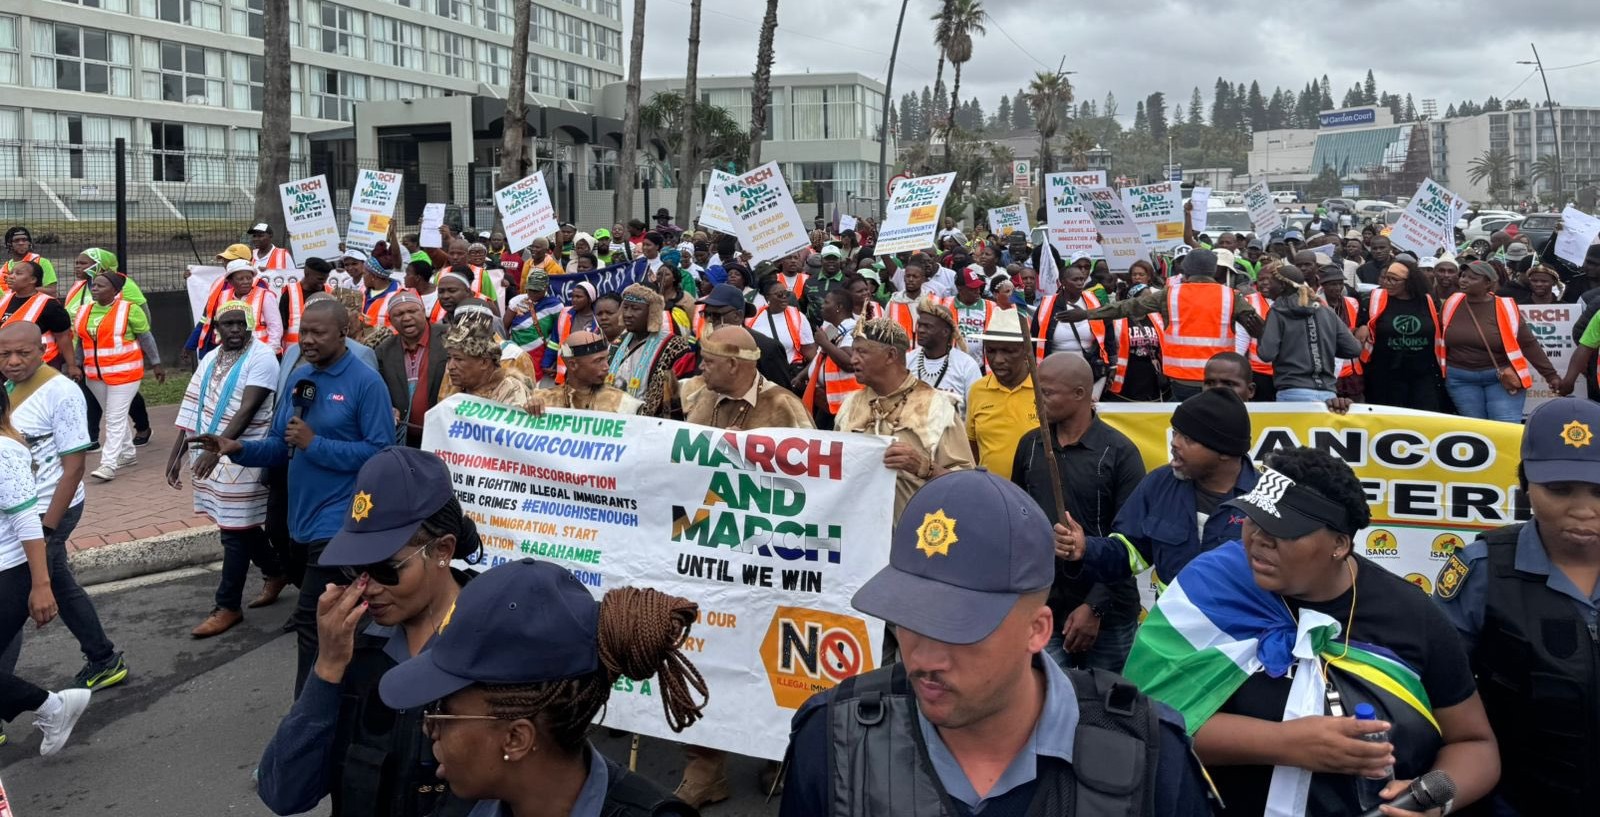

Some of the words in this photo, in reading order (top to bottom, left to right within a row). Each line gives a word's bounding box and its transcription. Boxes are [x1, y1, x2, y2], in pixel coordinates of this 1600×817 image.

[1329, 113, 1352, 123] Garden
[1354, 112, 1372, 120] Court
[365, 172, 396, 183] MARCH
[369, 181, 387, 190] AND
[724, 168, 773, 195] MARCH
[901, 176, 947, 189] MARCH
[1053, 175, 1099, 186] MARCH
[286, 179, 321, 196] MARCH
[502, 176, 538, 198] MARCH
[512, 187, 533, 200] AND
[740, 184, 767, 198] AND
[909, 186, 934, 195] AND
[1130, 184, 1171, 196] MARCH
[295, 192, 316, 203] AND
[1080, 190, 1113, 201] MARCH
[1140, 195, 1164, 203] AND
[742, 211, 757, 221] UNTIL
[769, 201, 778, 209] WIN
[1092, 201, 1112, 210] AND
[1430, 197, 1450, 212] AND
[759, 212, 784, 227] DEMAND
[752, 229, 775, 243] JUSTICE
[778, 221, 790, 231] AND
[756, 231, 795, 251] PROTECTION
[1520, 309, 1570, 322] ARCH
[1527, 322, 1556, 335] ND
[455, 400, 627, 438] #DOIT4THEIRFUTURE
[448, 421, 627, 463] #DOIT4YOURCOUNTRY
[1252, 428, 1490, 468] ANCO
[670, 428, 843, 480] MARCH
[435, 449, 617, 490] #STOPHOMEAFFAIRSCORRUPTION
[453, 473, 463, 484] US
[466, 475, 475, 486] IN
[478, 476, 527, 494] FIGHTING
[530, 484, 570, 500] ILLEGAL
[573, 491, 638, 510] IMMIGRANTS
[703, 471, 806, 517] AND
[453, 489, 475, 504] THEIR
[479, 495, 517, 511] CRIMES
[522, 499, 638, 527] #ENOUGHISENOUGH
[490, 515, 558, 536] IMMIGRATION,
[562, 526, 598, 542] START
[671, 505, 841, 564] MARCH
[481, 534, 514, 550] RATION
[521, 540, 601, 564] #ABAHAMBE
[1366, 548, 1398, 556] ISANCO
[677, 553, 733, 582] UNTIL
[742, 564, 773, 587] WE
[782, 569, 822, 593] WIN
[1450, 558, 1467, 576] POLICE
[707, 611, 737, 628] OUR
[640, 680, 652, 695] A
[777, 678, 808, 690] ILLEGAL
